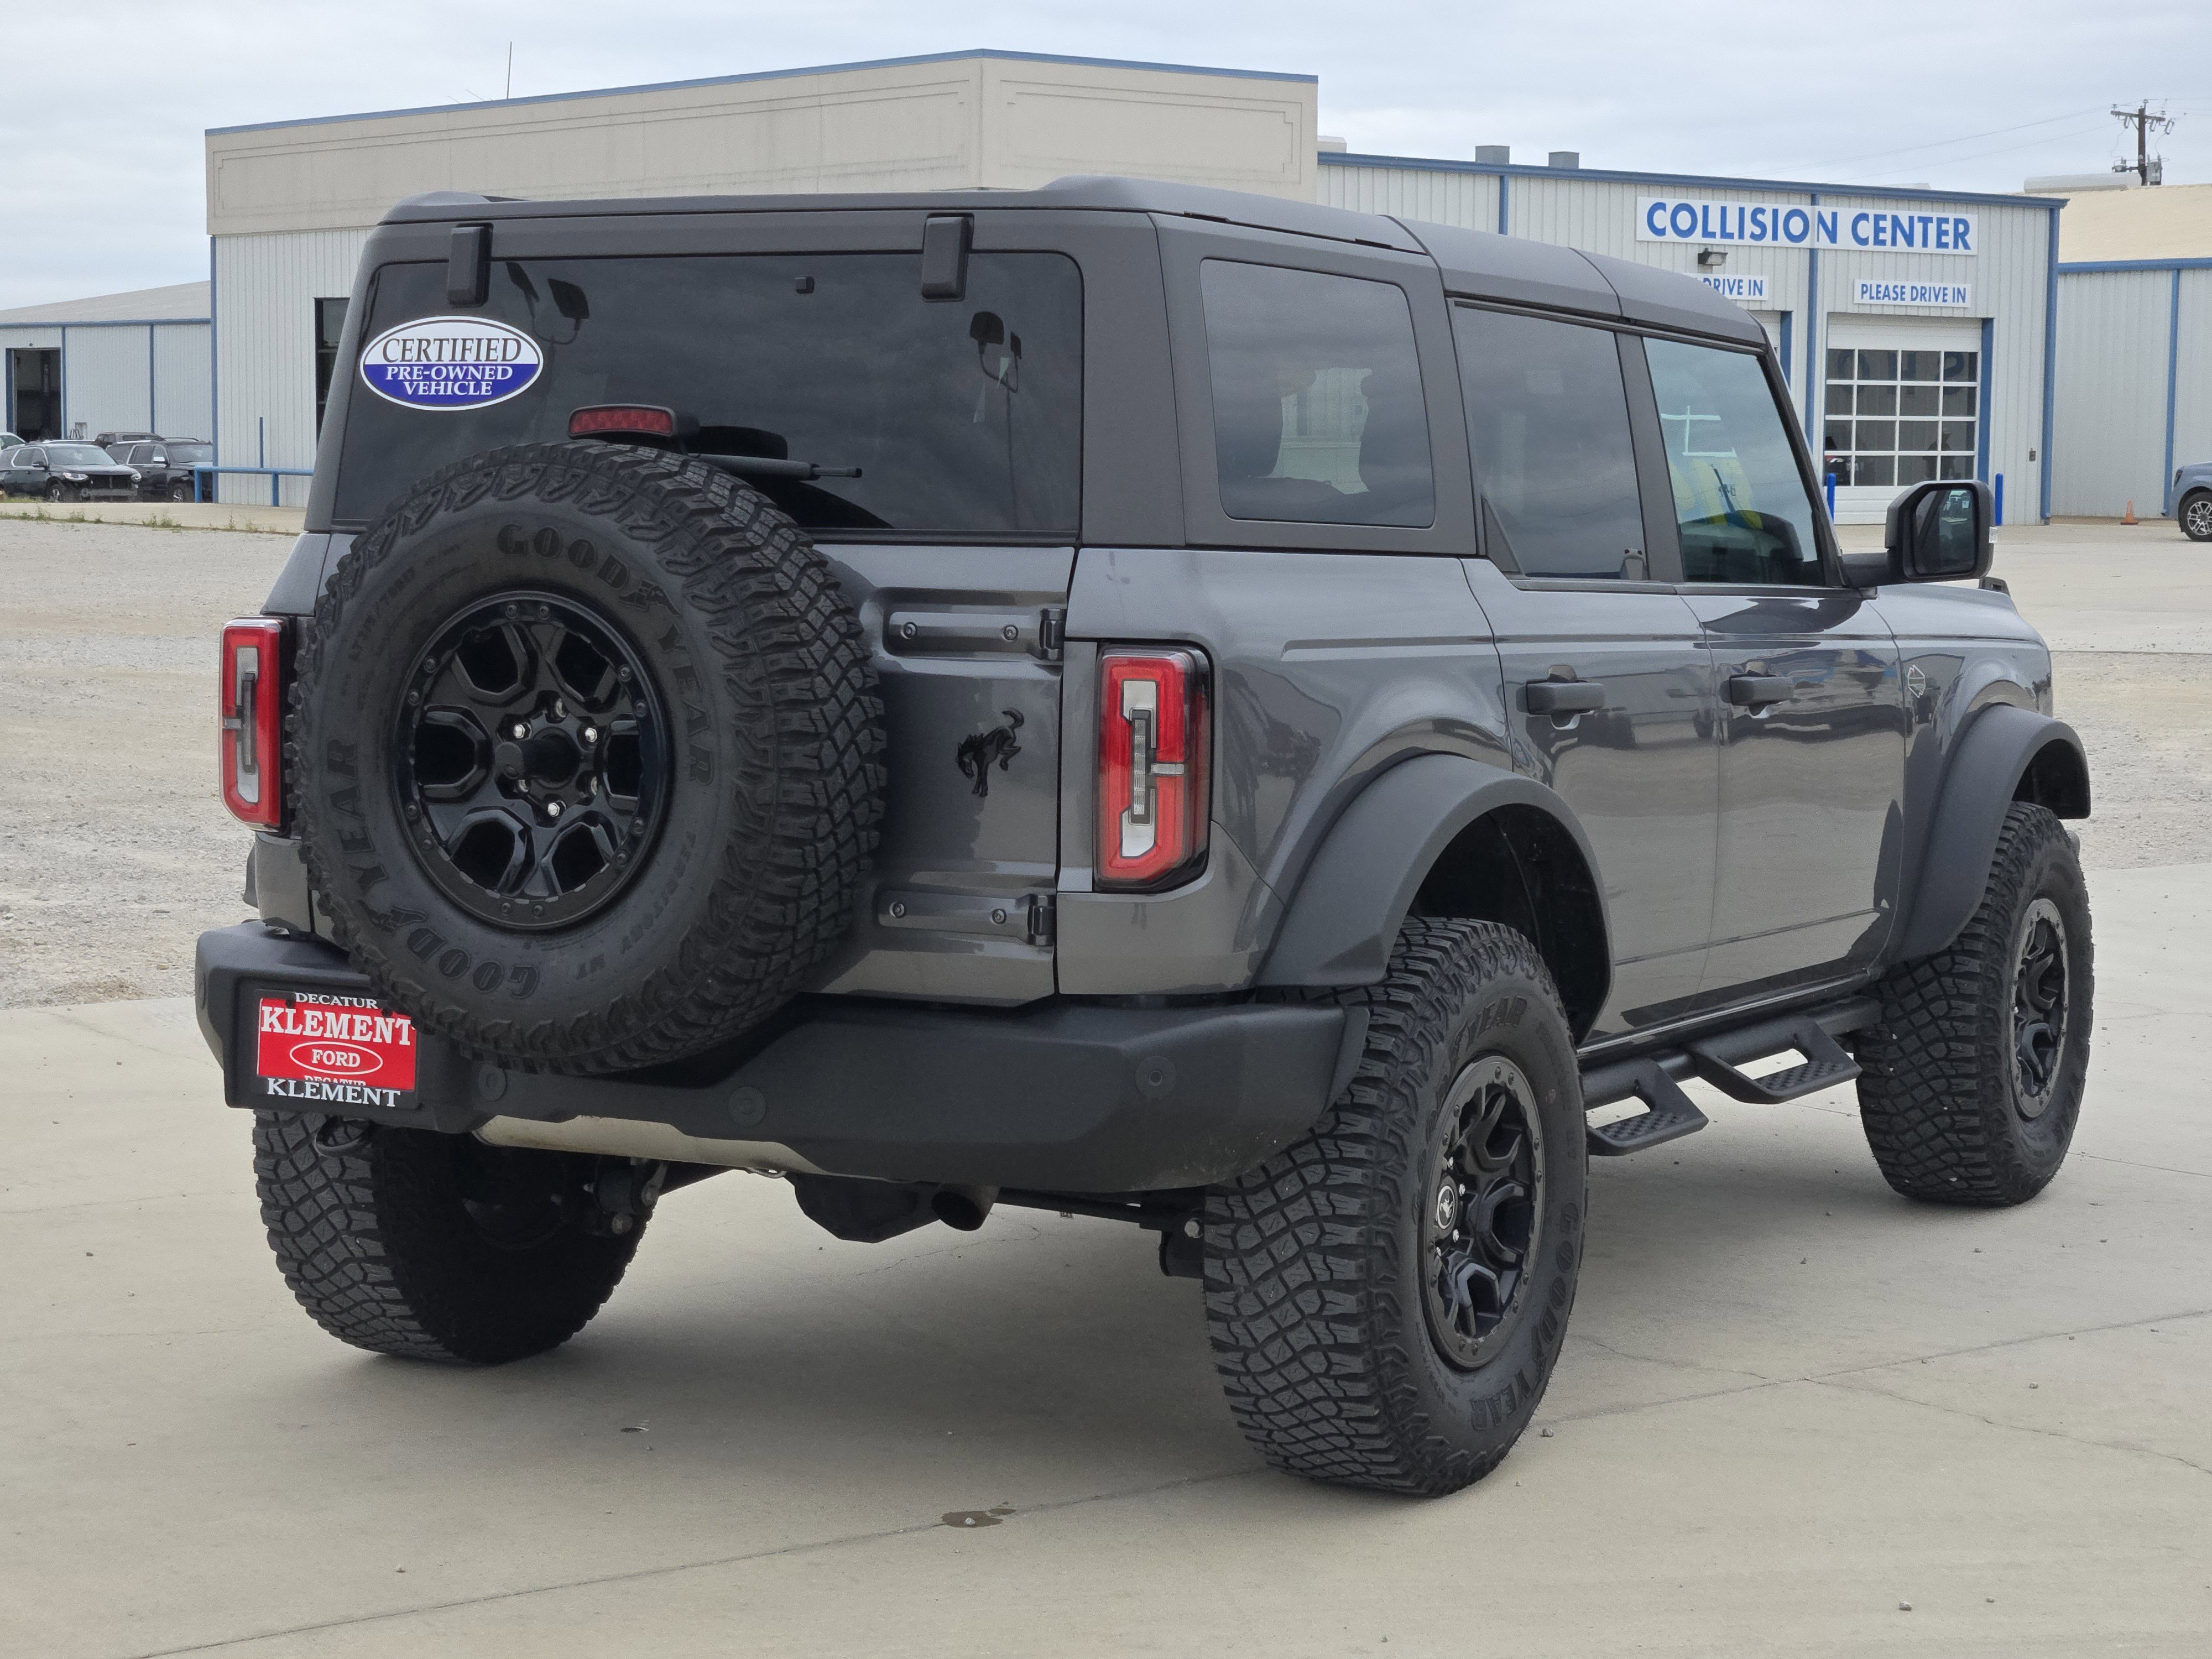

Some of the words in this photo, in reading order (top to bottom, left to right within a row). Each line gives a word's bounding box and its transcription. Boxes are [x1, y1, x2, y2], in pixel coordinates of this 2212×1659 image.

[1646, 202, 1838, 244] COLLISION
[1851, 212, 1971, 250] CENTER
[1748, 280, 1763, 296] IN
[1861, 283, 1906, 301] PLEASE
[1911, 285, 1948, 302] DRIVE
[1952, 287, 1966, 303] IN
[383, 338, 521, 363] CERTIFIED
[386, 366, 513, 380] PRE-OWNED
[403, 382, 492, 395] VEHICLE
[294, 992, 378, 1009] DECATUR
[261, 1006, 411, 1045] KLEMENT
[311, 1048, 360, 1067] FORD
[267, 1078, 400, 1107] KLEMENT
